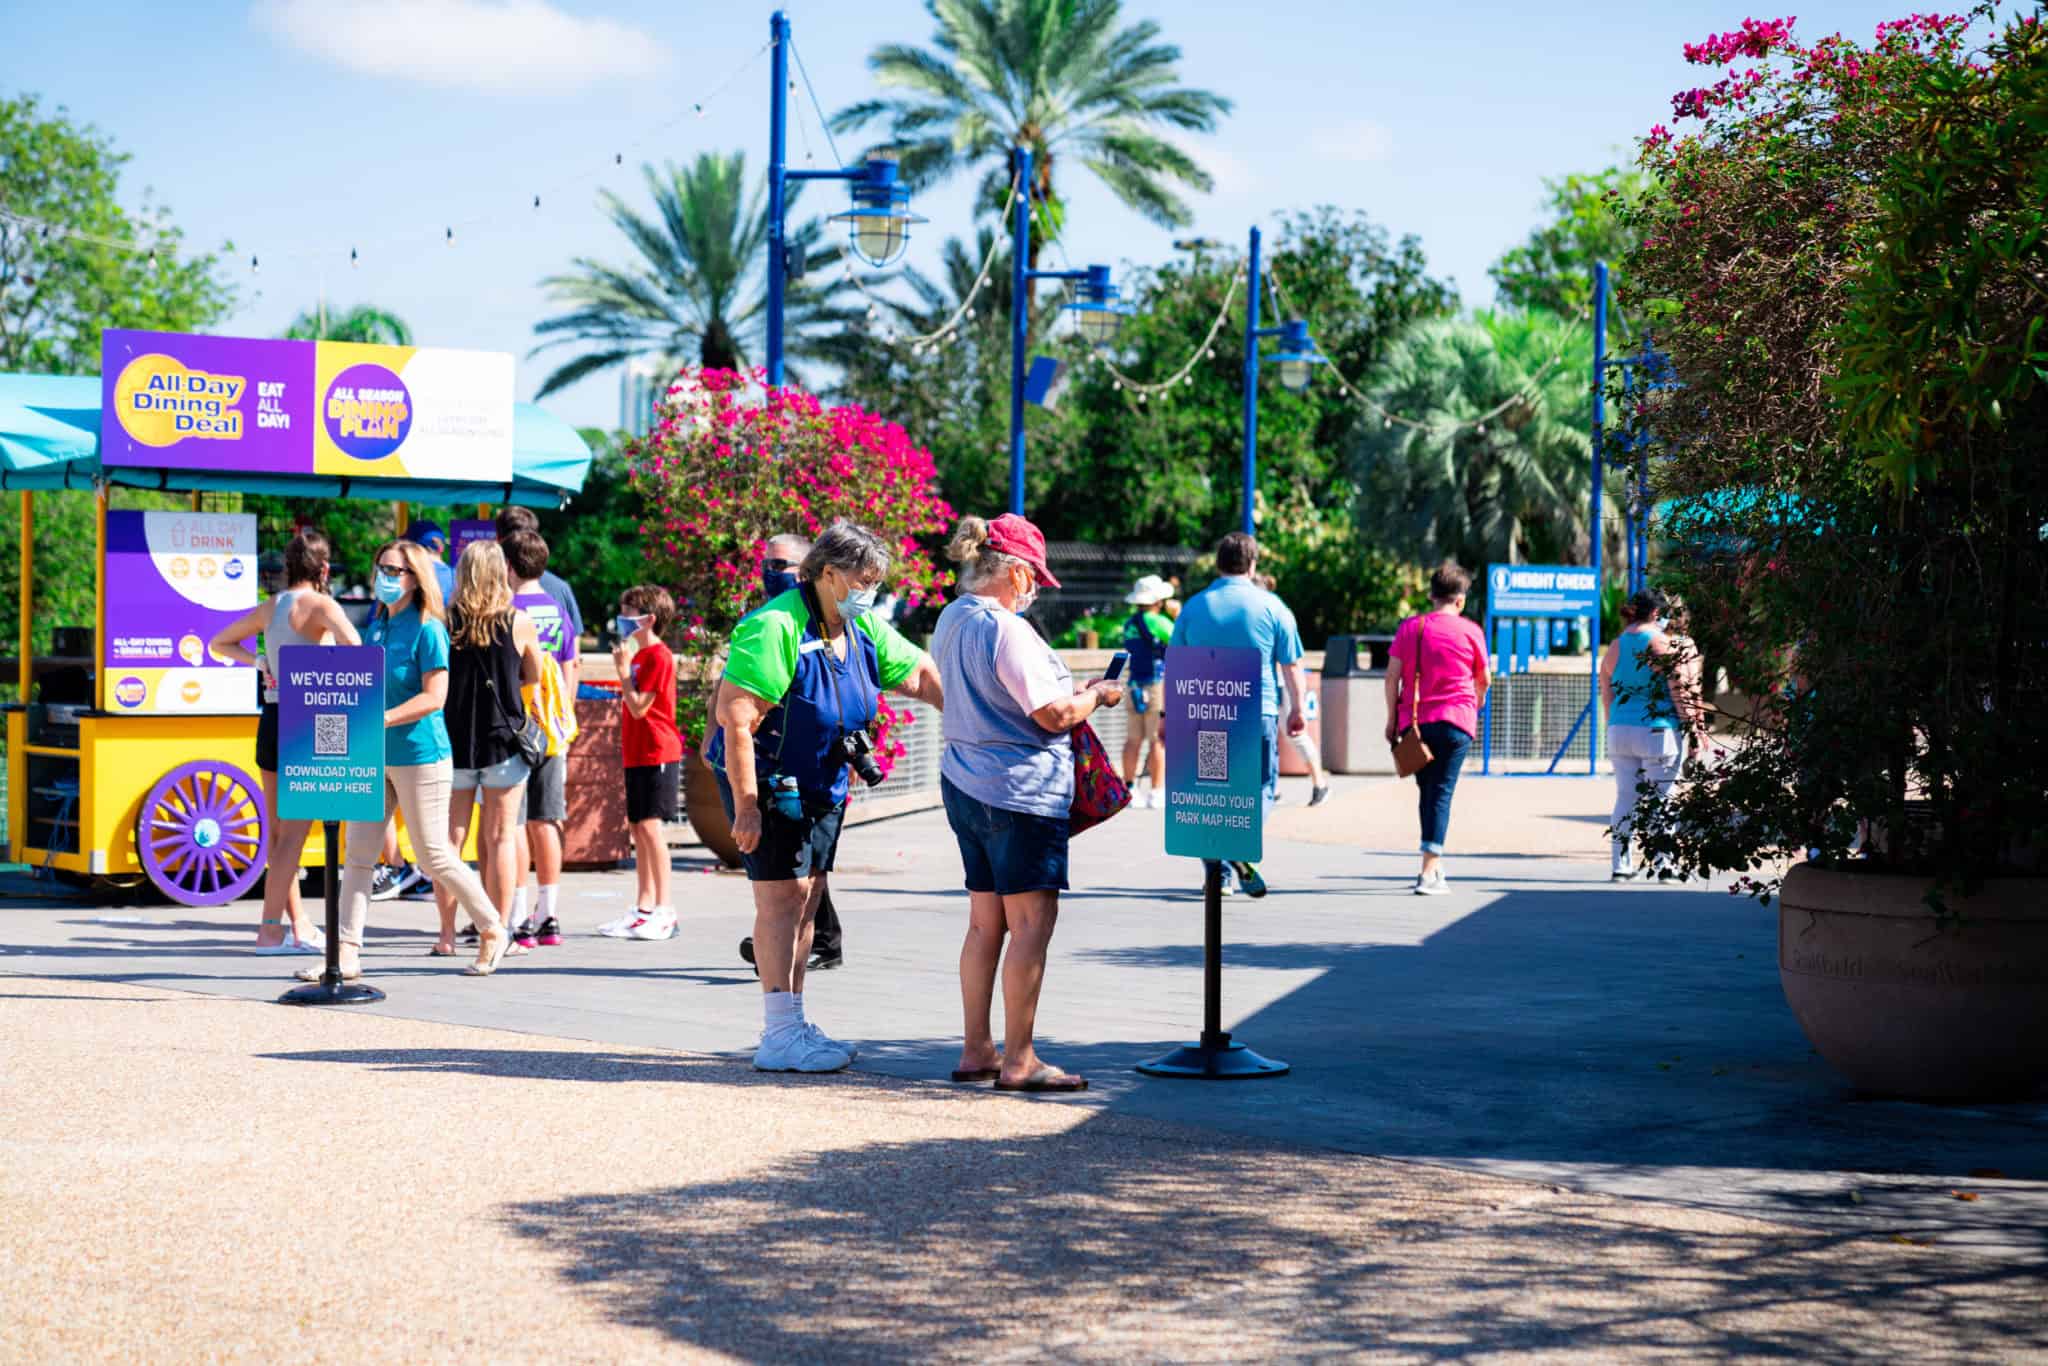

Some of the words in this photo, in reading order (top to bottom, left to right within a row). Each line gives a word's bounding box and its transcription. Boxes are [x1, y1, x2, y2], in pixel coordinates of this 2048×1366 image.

[148, 374, 180, 392] All
[187, 377, 239, 398] Day
[257, 382, 286, 398] EAT
[332, 387, 355, 401] ALL
[133, 393, 221, 417] Dining
[257, 398, 283, 413] ALL
[175, 415, 238, 433] Deal
[190, 535, 234, 548] DRINK
[290, 671, 333, 686] WE'VE
[336, 672, 373, 686] GONE
[1175, 678, 1214, 696] WE'VE
[1216, 680, 1251, 697] GONE
[304, 692, 359, 706] DIGITAL!
[1188, 703, 1238, 721] DIGITAL!
[285, 765, 346, 777] DOWNLOAD
[349, 767, 377, 777] YOUR
[289, 781, 317, 792] PARK
[319, 782, 342, 793] MAP
[344, 782, 372, 793] HERE
[1171, 791, 1226, 809] DOWNLOAD
[1227, 796, 1255, 809] YOUR
[1175, 810, 1200, 825] PARK
[1202, 812, 1224, 826] MAP
[1225, 814, 1251, 829] HERE
